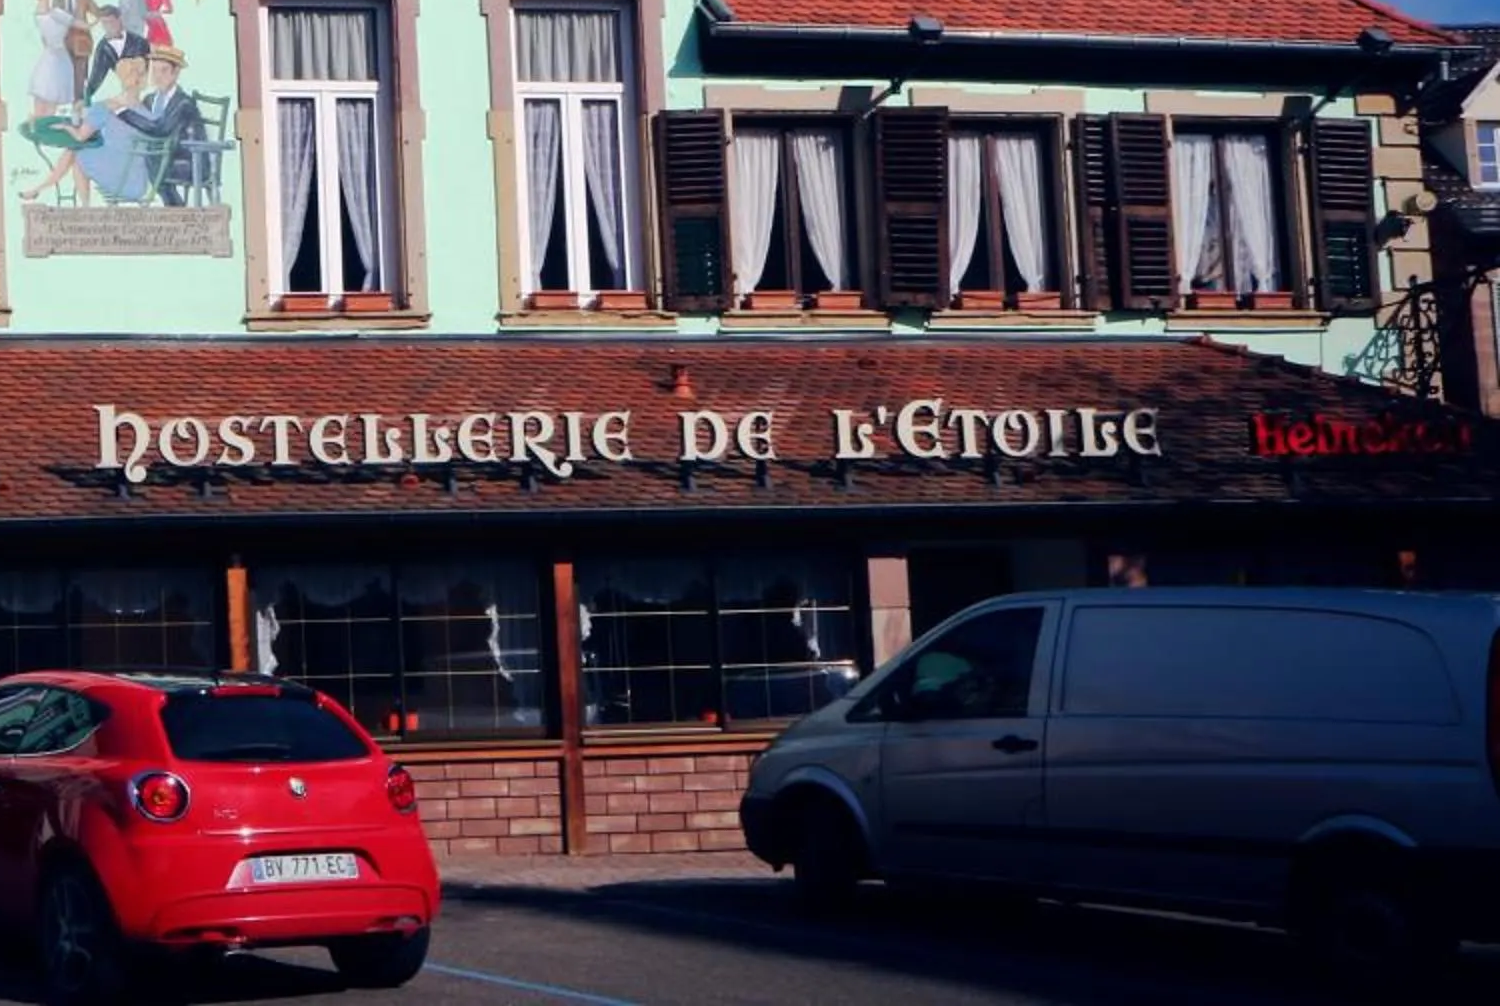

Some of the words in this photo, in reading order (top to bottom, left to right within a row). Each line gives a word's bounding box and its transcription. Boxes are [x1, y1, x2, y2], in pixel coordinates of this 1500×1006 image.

[94, 404, 634, 482] HOSTELLERIE
[681, 410, 777, 462] DE
[834, 399, 1163, 460] L'ETOILE
[1253, 413, 1474, 457] Heine
